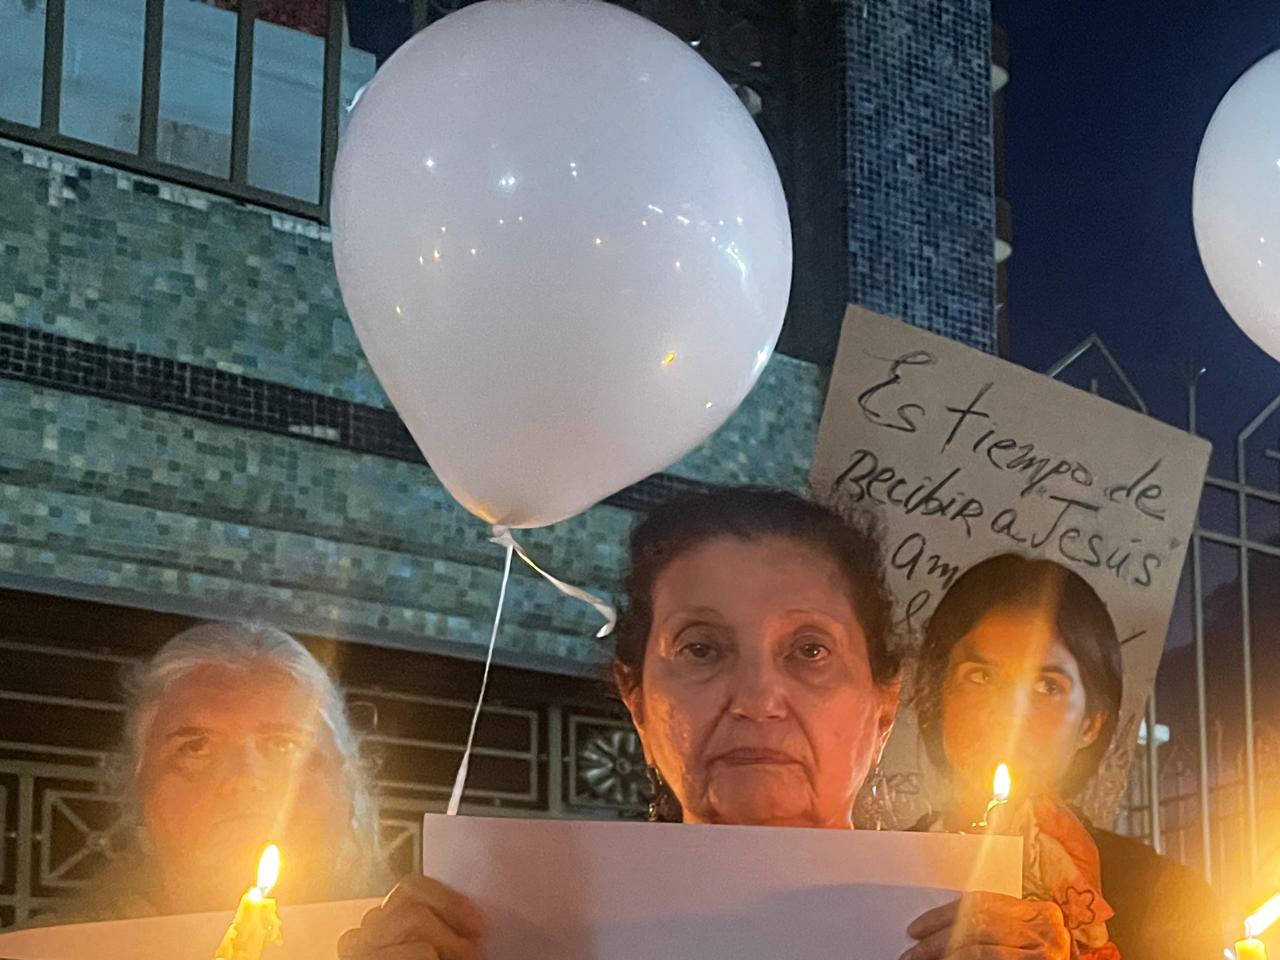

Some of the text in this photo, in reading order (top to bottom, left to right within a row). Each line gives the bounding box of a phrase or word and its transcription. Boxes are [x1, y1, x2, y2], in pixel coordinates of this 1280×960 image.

[857, 350, 1165, 520] Es tiempo de
[990, 508, 1027, 543] a
[1031, 495, 1161, 587] Jesús
